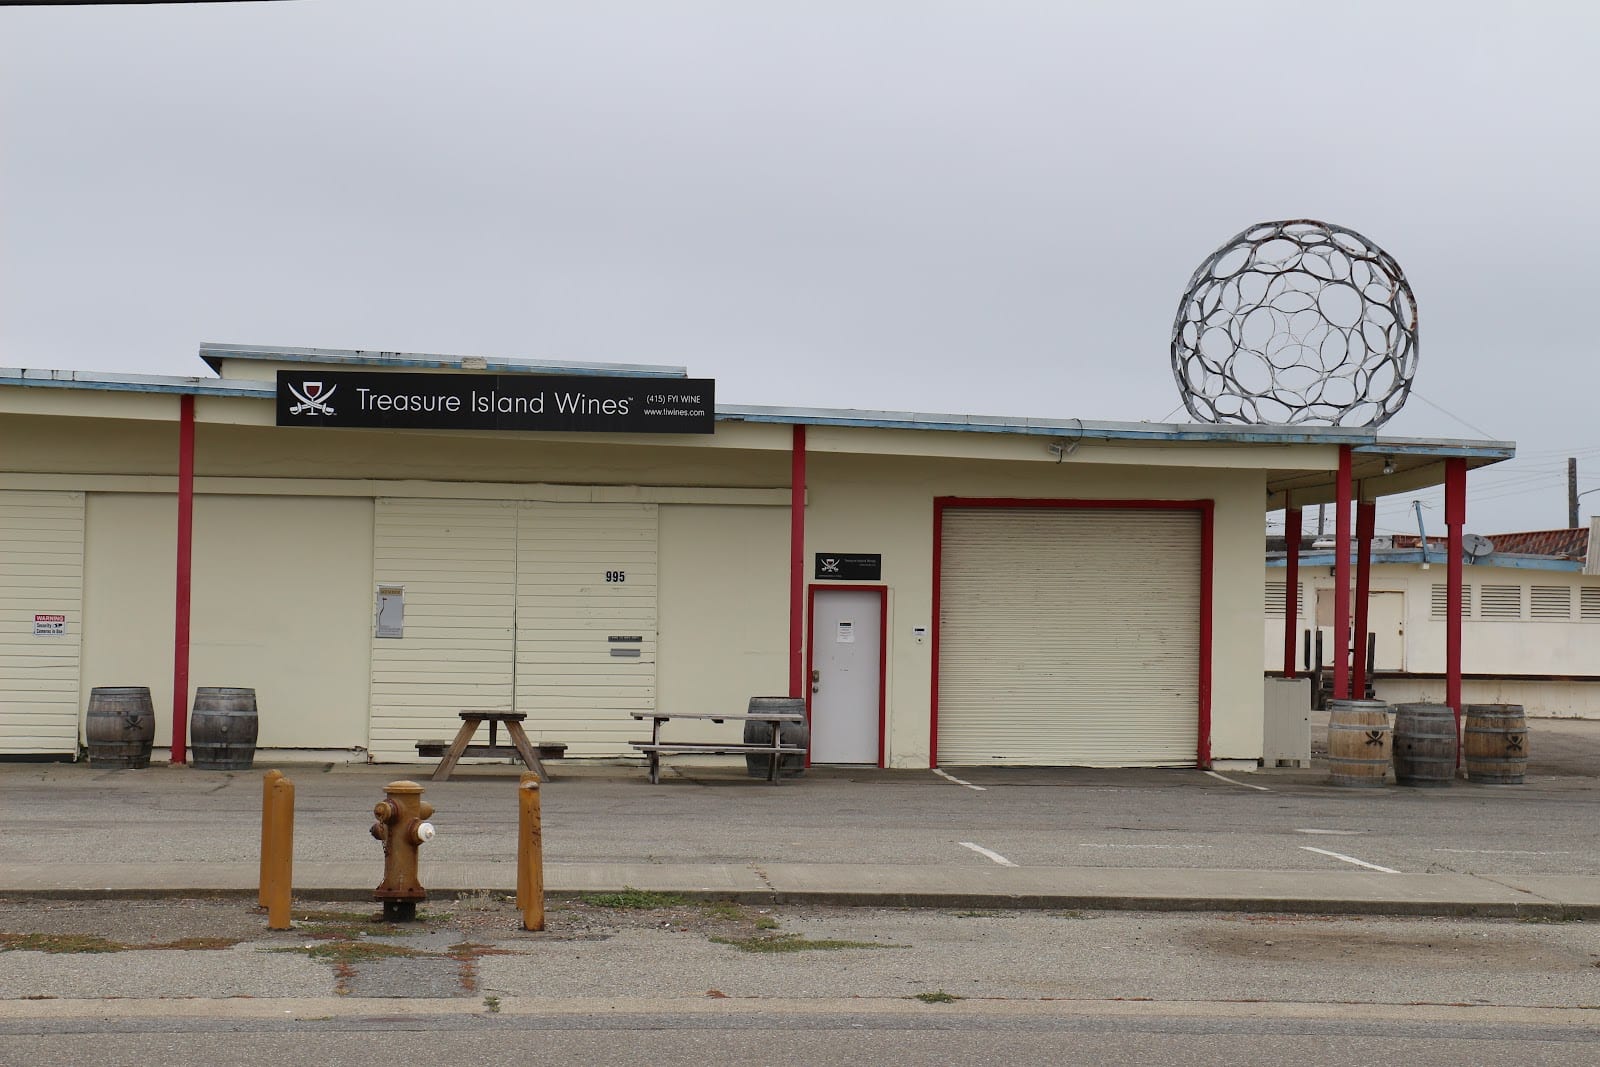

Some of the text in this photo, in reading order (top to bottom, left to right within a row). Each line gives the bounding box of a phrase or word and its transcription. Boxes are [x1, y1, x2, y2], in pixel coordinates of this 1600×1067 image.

[356, 388, 461, 412] Treasure
[472, 390, 544, 414] Island
[646, 394, 701, 404] (415) FYI WINE
[644, 408, 704, 416] www.tiwines.com
[606, 571, 625, 582] 995
